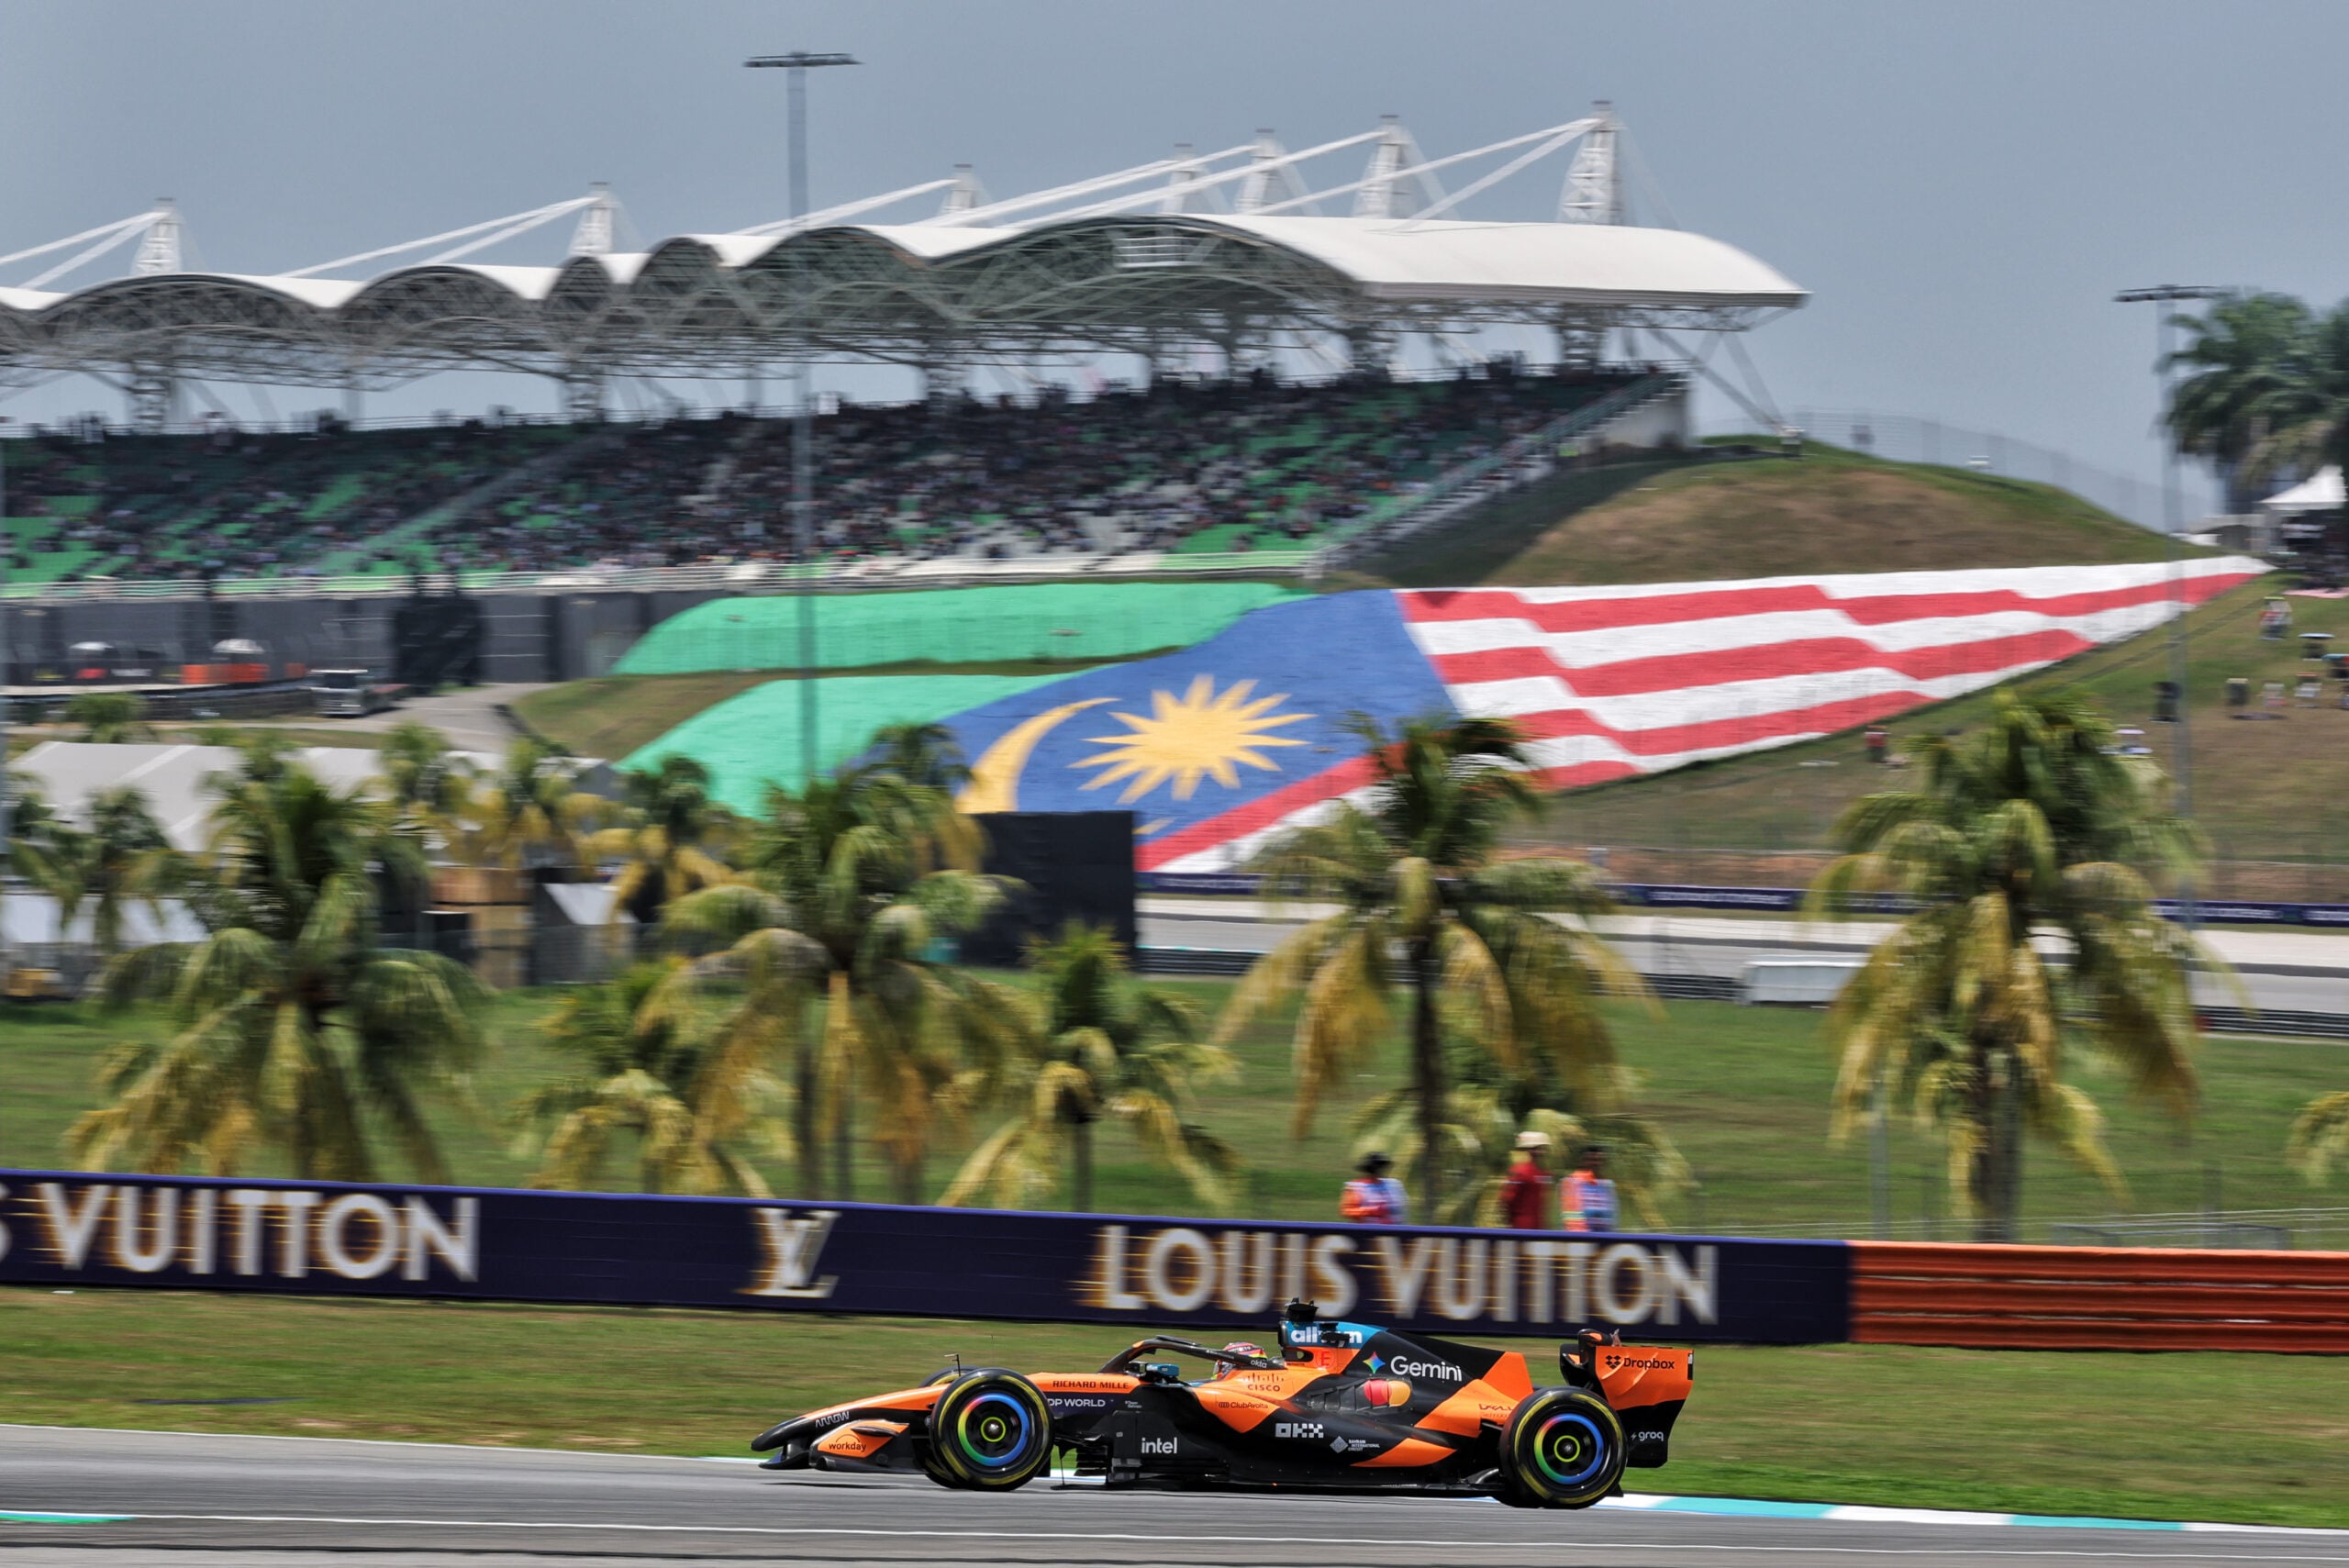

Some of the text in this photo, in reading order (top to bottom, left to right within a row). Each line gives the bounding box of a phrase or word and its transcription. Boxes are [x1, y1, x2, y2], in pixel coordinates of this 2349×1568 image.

[38, 1182, 479, 1283] VUITTON
[1097, 1225, 1719, 1325] LOUIS VUITTON
[1250, 1359, 1267, 1369] okta
[1390, 1355, 1463, 1382] Gemini
[1623, 1357, 1675, 1370] Dropbox
[1052, 1380, 1130, 1390] RICHARD MILLE
[1247, 1384, 1281, 1393] CISCO
[1064, 1398, 1106, 1407] WORLD
[1275, 1422, 1324, 1439] OKX
[1638, 1431, 1664, 1442] groq
[829, 1441, 867, 1452] workday
[1141, 1437, 1178, 1454] intel
